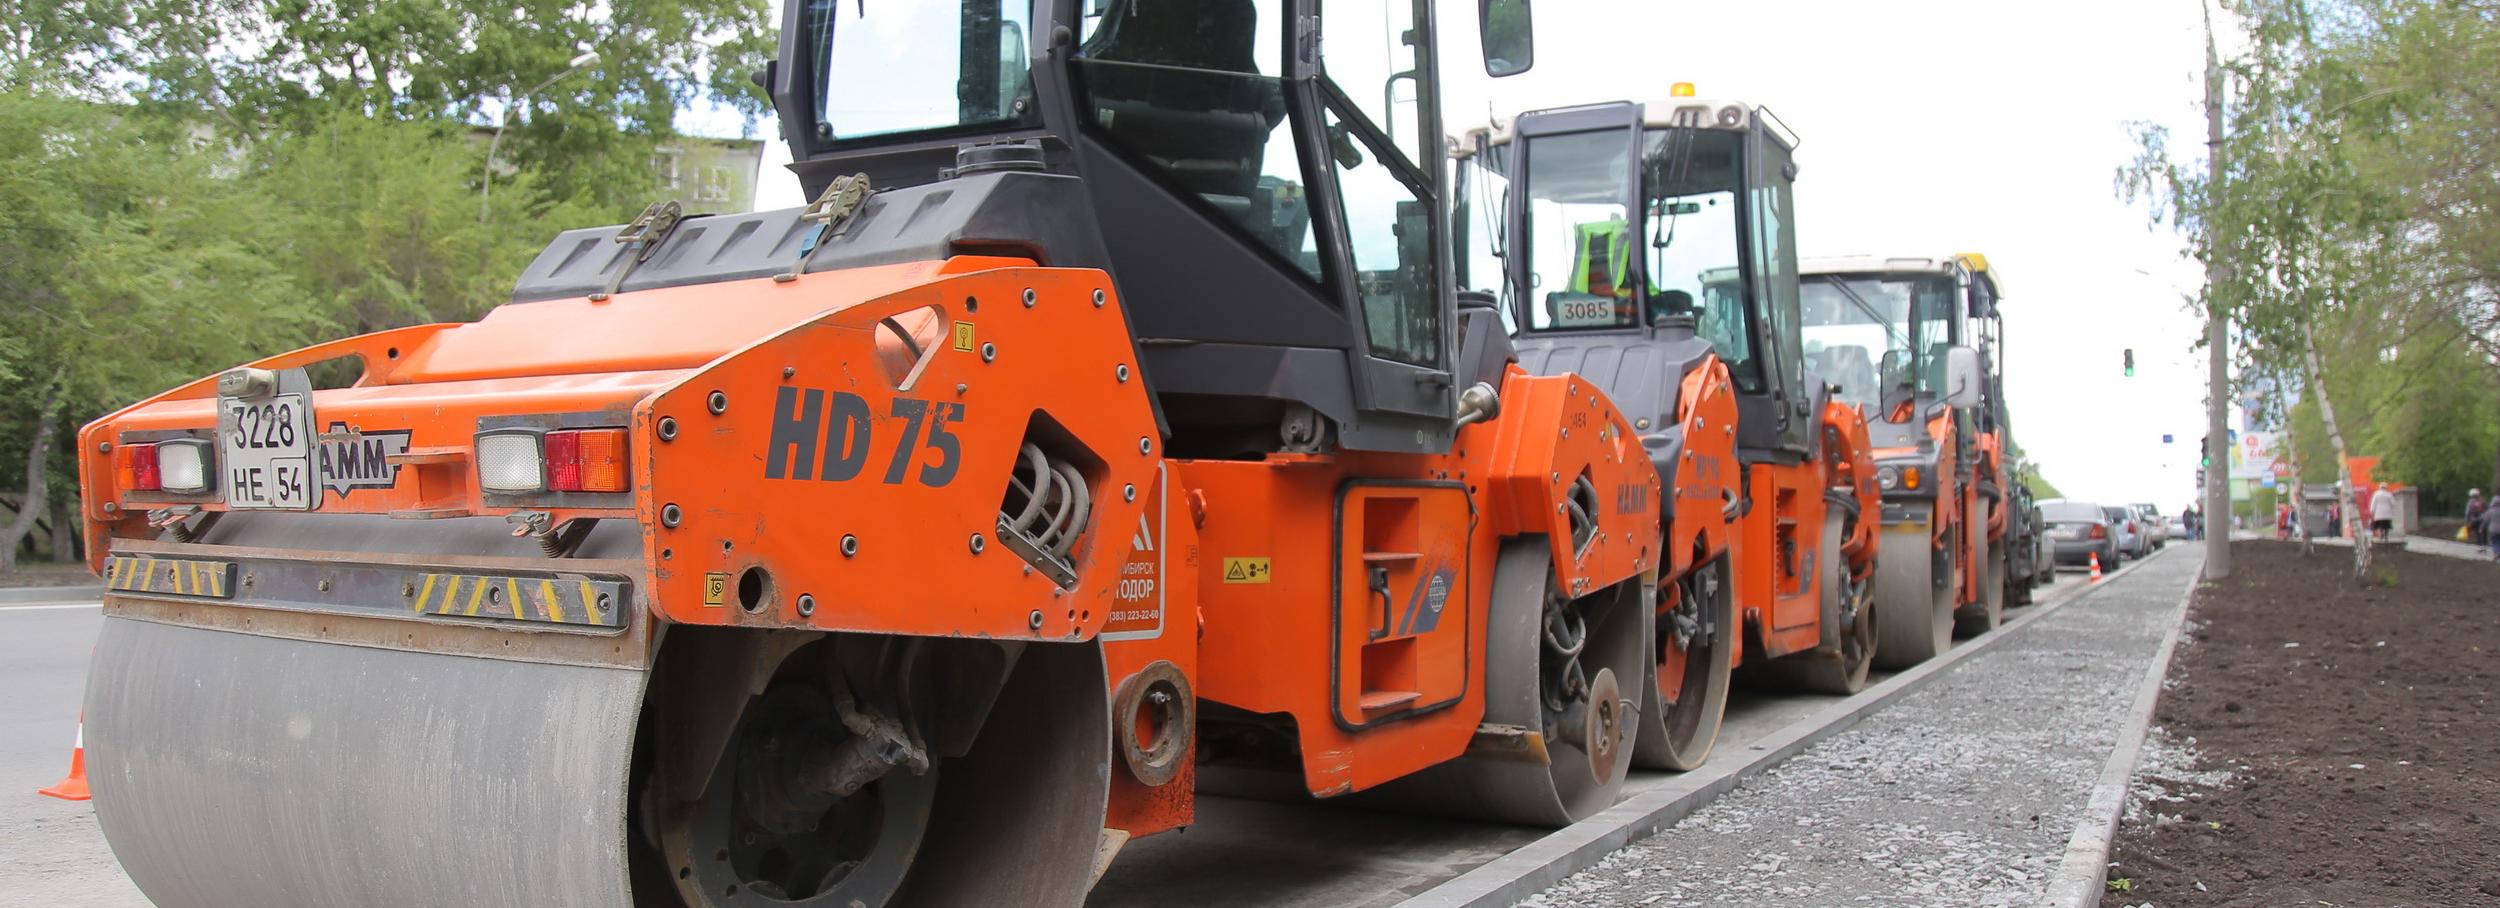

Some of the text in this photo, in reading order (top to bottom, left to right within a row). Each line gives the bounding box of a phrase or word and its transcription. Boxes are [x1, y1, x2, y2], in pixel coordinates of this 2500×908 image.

[1564, 302, 1608, 319] 3085
[232, 403, 294, 449] 3228
[765, 385, 966, 488] HD 75
[320, 439, 388, 480] AMM
[277, 467, 302, 501] 54
[1122, 562, 1154, 575] ИБИРСК
